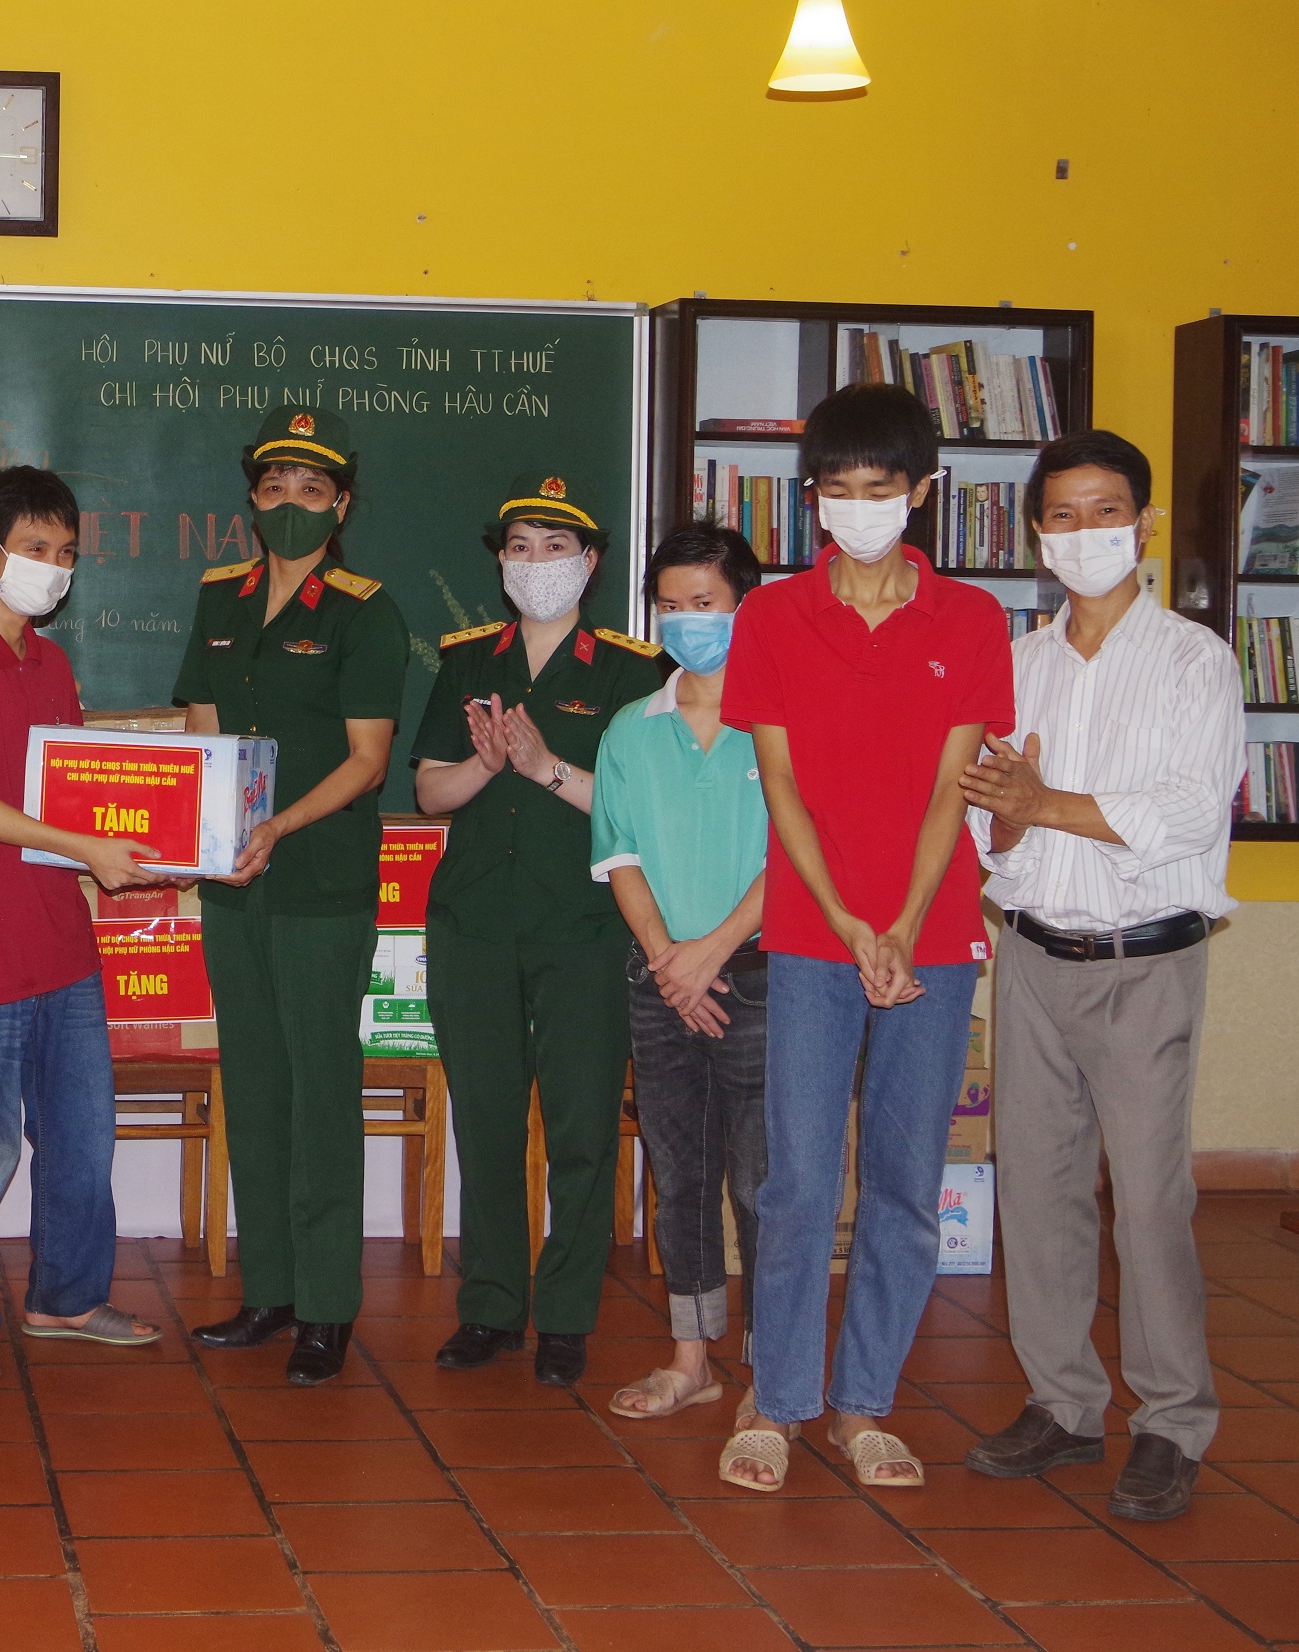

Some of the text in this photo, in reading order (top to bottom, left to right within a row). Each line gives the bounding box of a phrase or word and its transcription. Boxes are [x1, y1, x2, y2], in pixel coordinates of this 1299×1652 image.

[81, 334, 117, 368] HỘI
[144, 339, 188, 371] PHỤ
[200, 332, 235, 366] NỮ
[253, 335, 286, 372] BỘ
[310, 345, 378, 370] CHQS
[397, 337, 450, 372] TỈNH
[100, 381, 136, 407] CHI
[152, 376, 200, 413] HỘI
[220, 384, 269, 414] PHỤ
[339, 383, 430, 413] PHÒNG
[445, 385, 492, 419] HẬU
[503, 384, 549, 418] CẦN
[79, 499, 148, 564] IỆT
[96, 609, 120, 628] 10
[131, 612, 181, 633] năm
[67, 772, 79, 781] CHI
[102, 761, 120, 771] CHQS
[92, 803, 149, 837] TẶNG
[379, 882, 400, 902] NG
[117, 971, 168, 999] TẶNG
